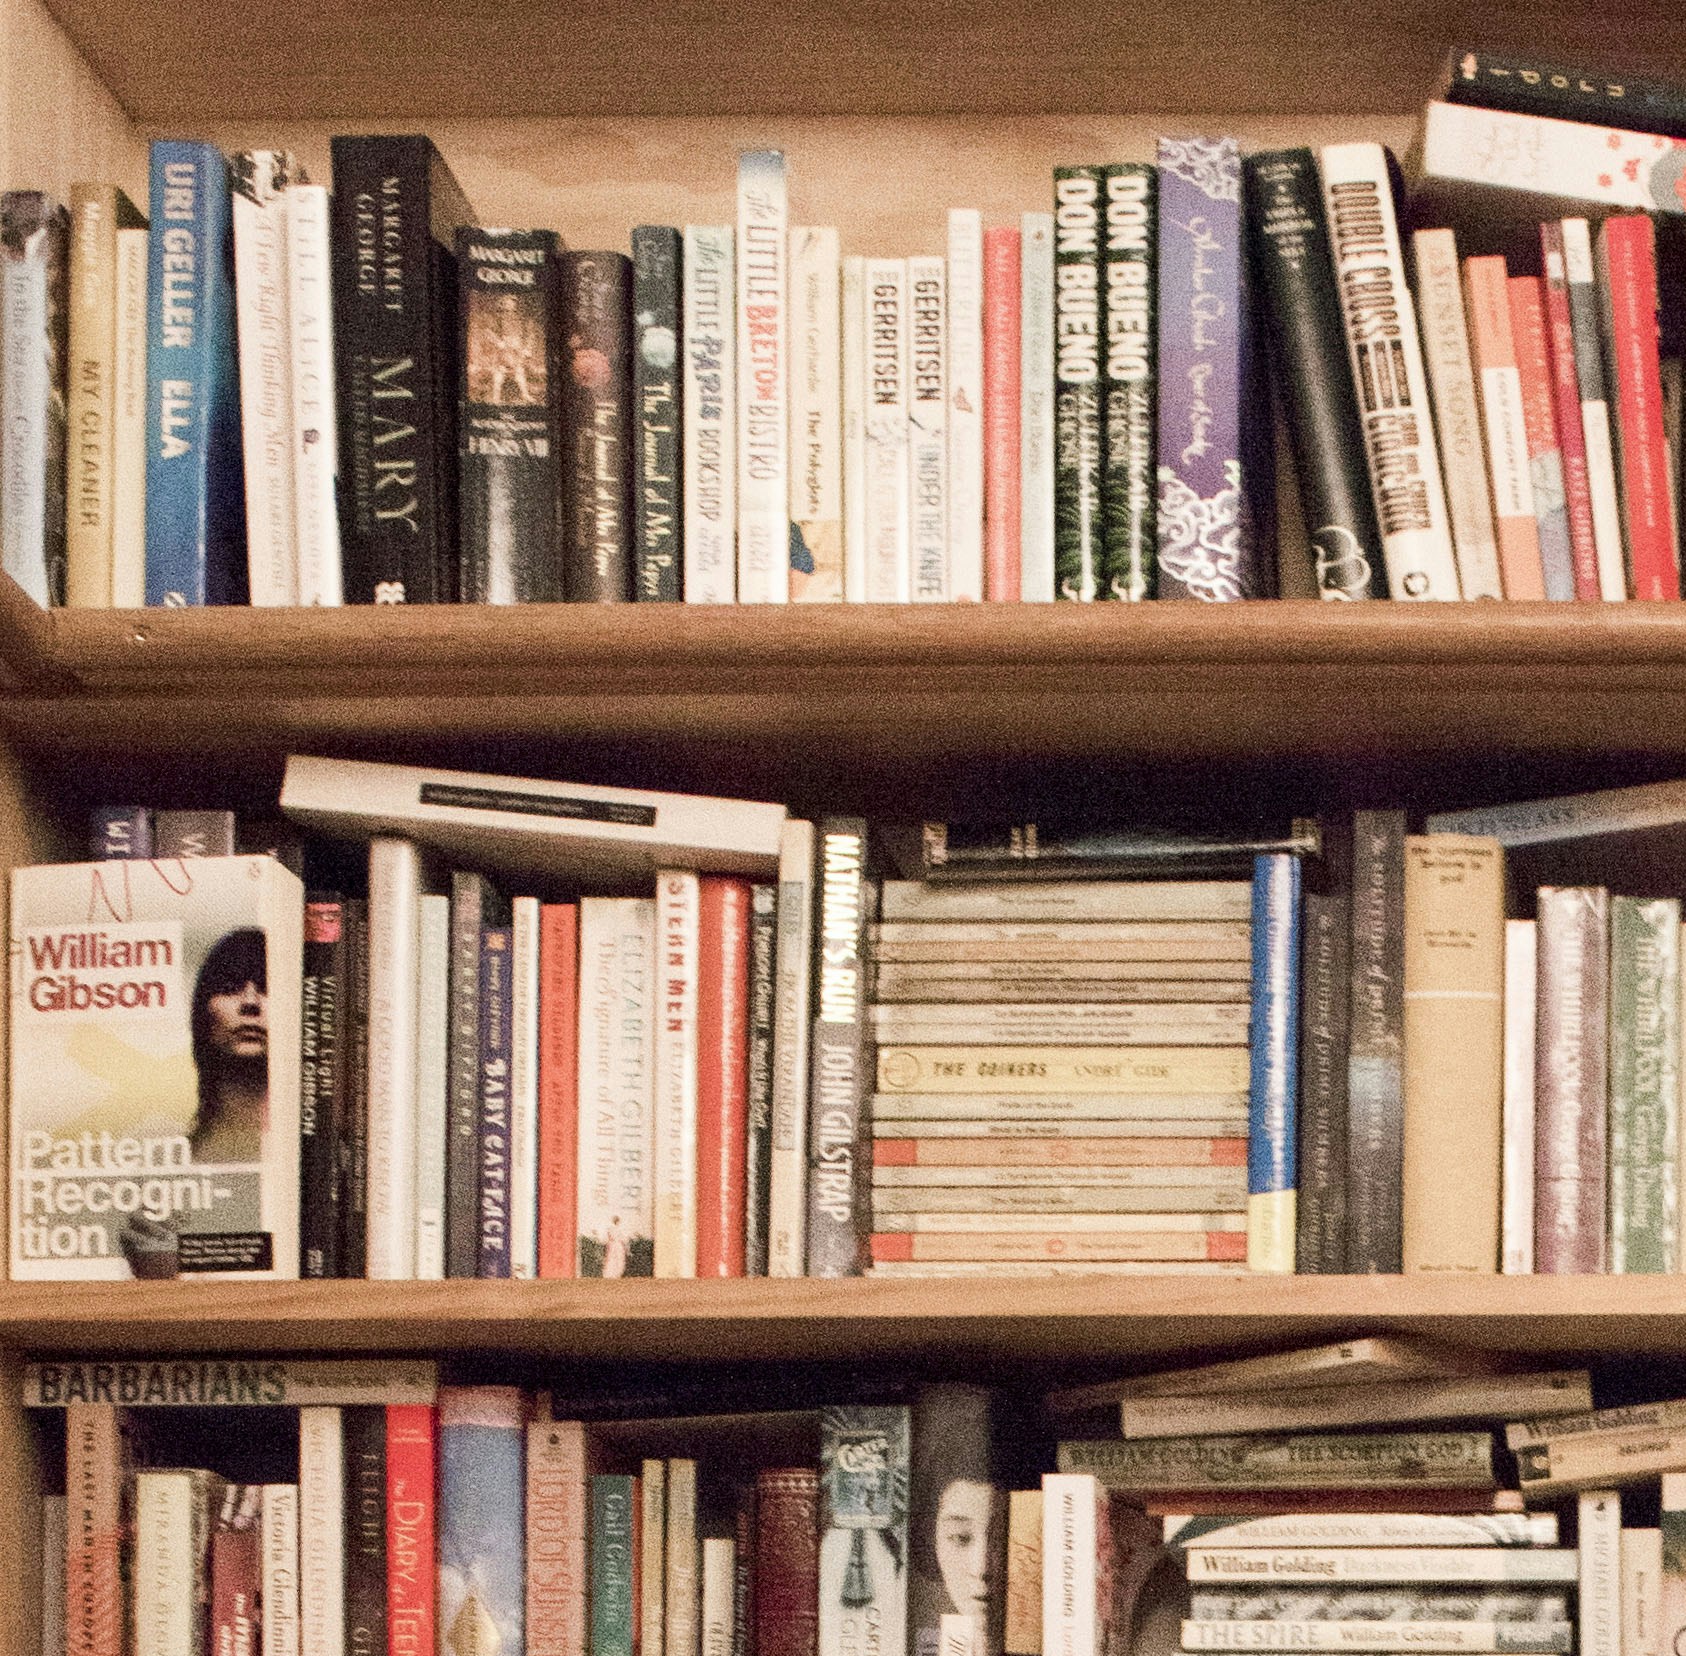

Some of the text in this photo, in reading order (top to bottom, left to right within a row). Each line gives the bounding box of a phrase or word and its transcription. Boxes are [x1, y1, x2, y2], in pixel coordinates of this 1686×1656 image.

[356, 193, 376, 298] GEORGE
[383, 177, 403, 315] MARGARET
[1057, 179, 1098, 383] DON BUENO
[1106, 175, 1149, 381] DON BUENO
[1330, 180, 1402, 343] DOUBLE CROSS
[161, 163, 195, 460] URI GELLER ELLA
[873, 284, 899, 405] GERRITSEN
[82, 361, 100, 528] MY CLEANER
[370, 356, 419, 534] MARY
[28, 932, 173, 972] William
[28, 973, 167, 1013] Gibson
[820, 834, 861, 1025] NATHAN'S RUN
[619, 933, 645, 1217] ELIZABETH GILBERT
[818, 1042, 853, 1224] JOHN GILSTRAP
[22, 1129, 192, 1171] Pattern
[22, 1171, 233, 1222] Recogni-
[19, 1221, 109, 1258] tion
[39, 1362, 287, 1404] BARBARIANS
[1062, 1492, 1075, 1552] WILLIAM
[1062, 1555, 1075, 1618] GOLDING
